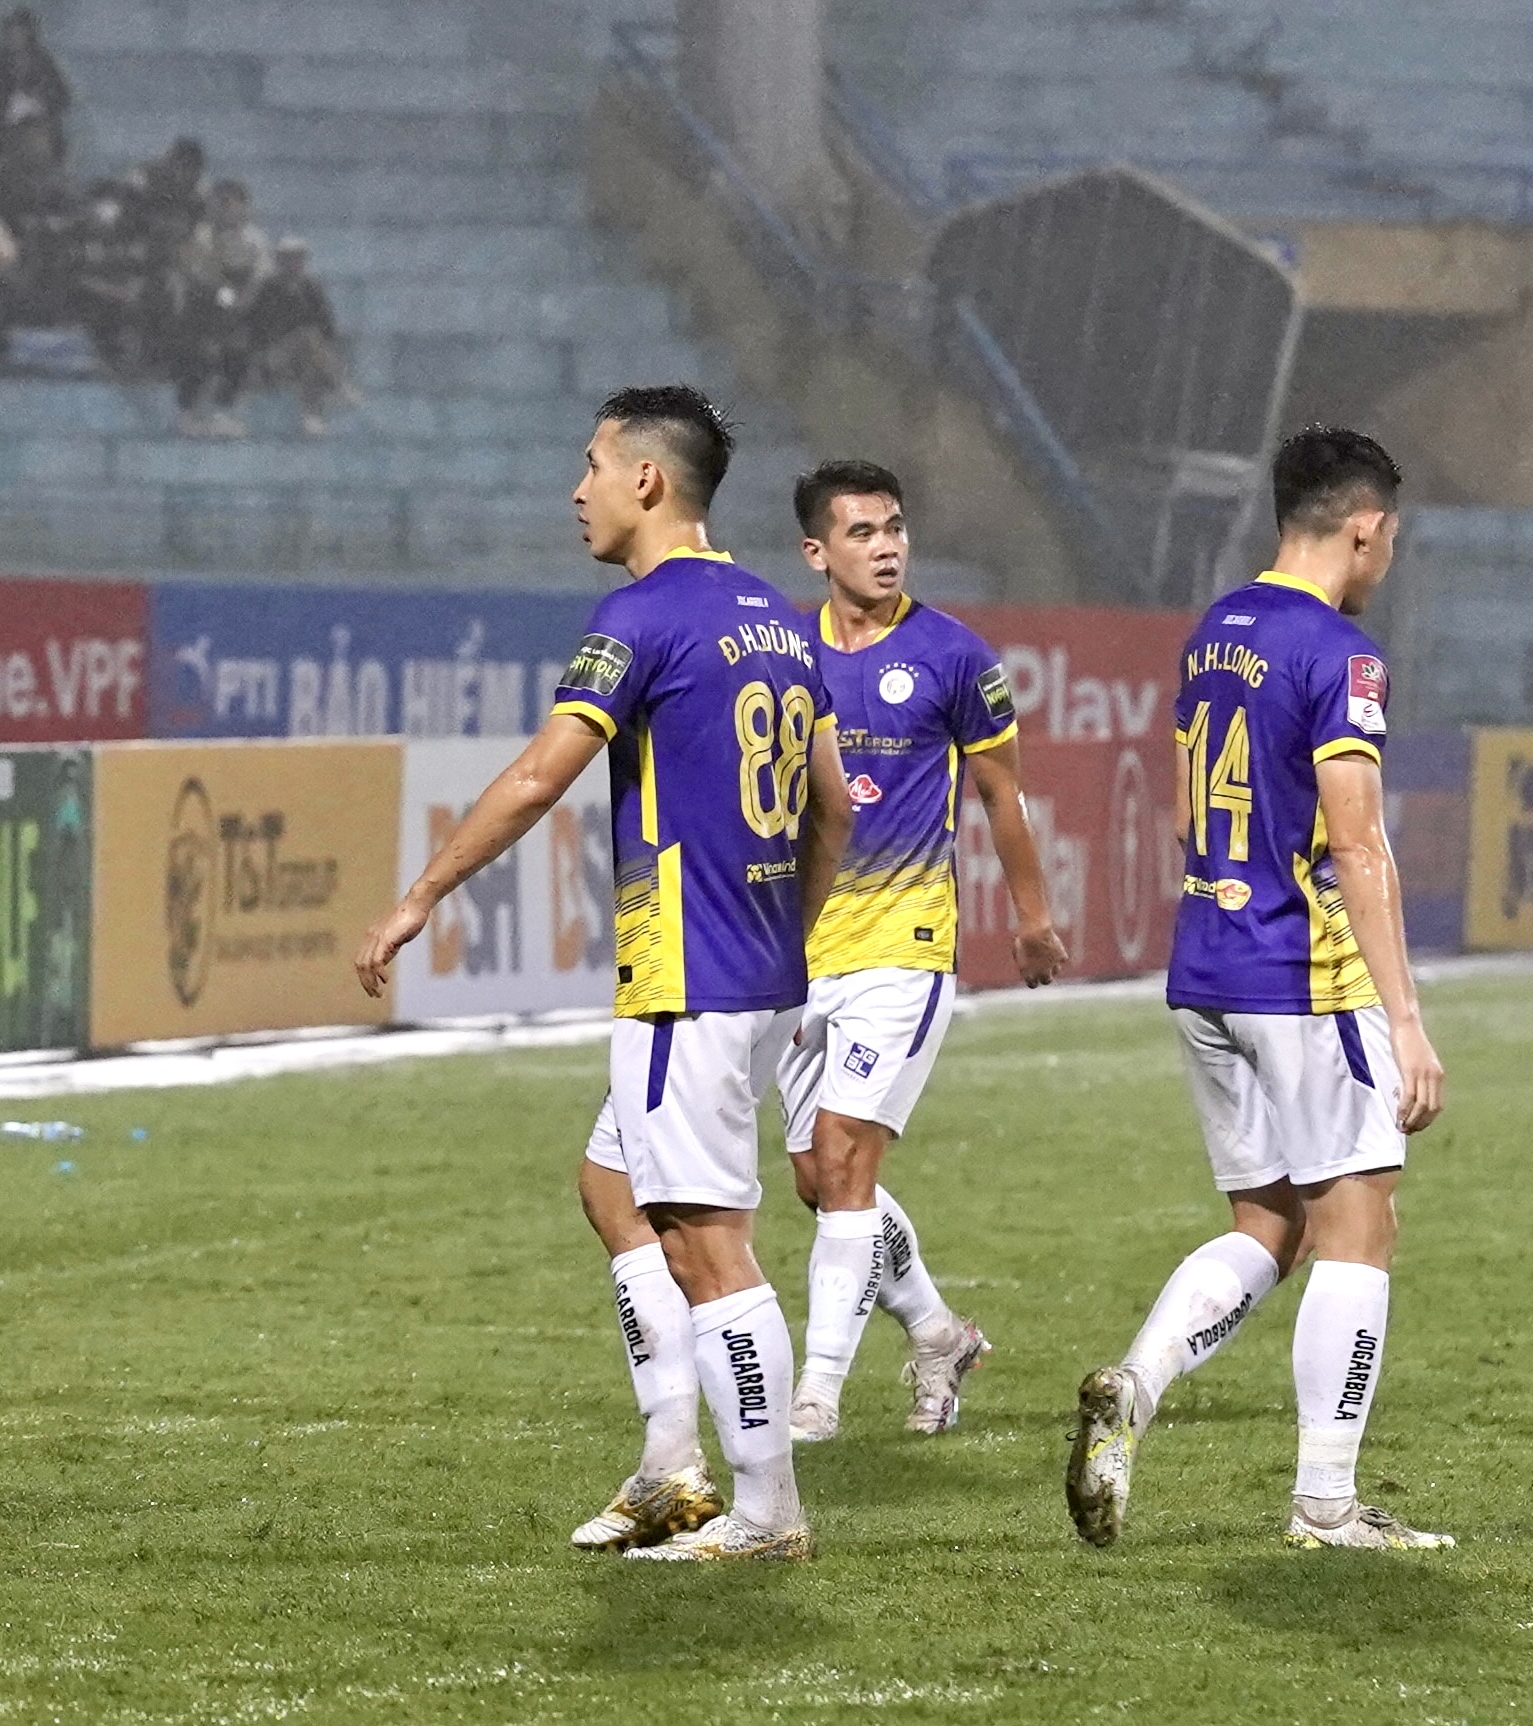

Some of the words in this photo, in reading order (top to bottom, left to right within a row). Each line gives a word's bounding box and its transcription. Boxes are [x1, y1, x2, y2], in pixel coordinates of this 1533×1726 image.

[1187, 642, 1269, 689] N.H.LONG
[734, 680, 815, 840] 88
[1187, 700, 1252, 862] 14
[616, 1281, 651, 1367] GARBOLA
[722, 1329, 769, 1430] JOGARBOLA
[1334, 1329, 1378, 1421] JOGARBOLA
